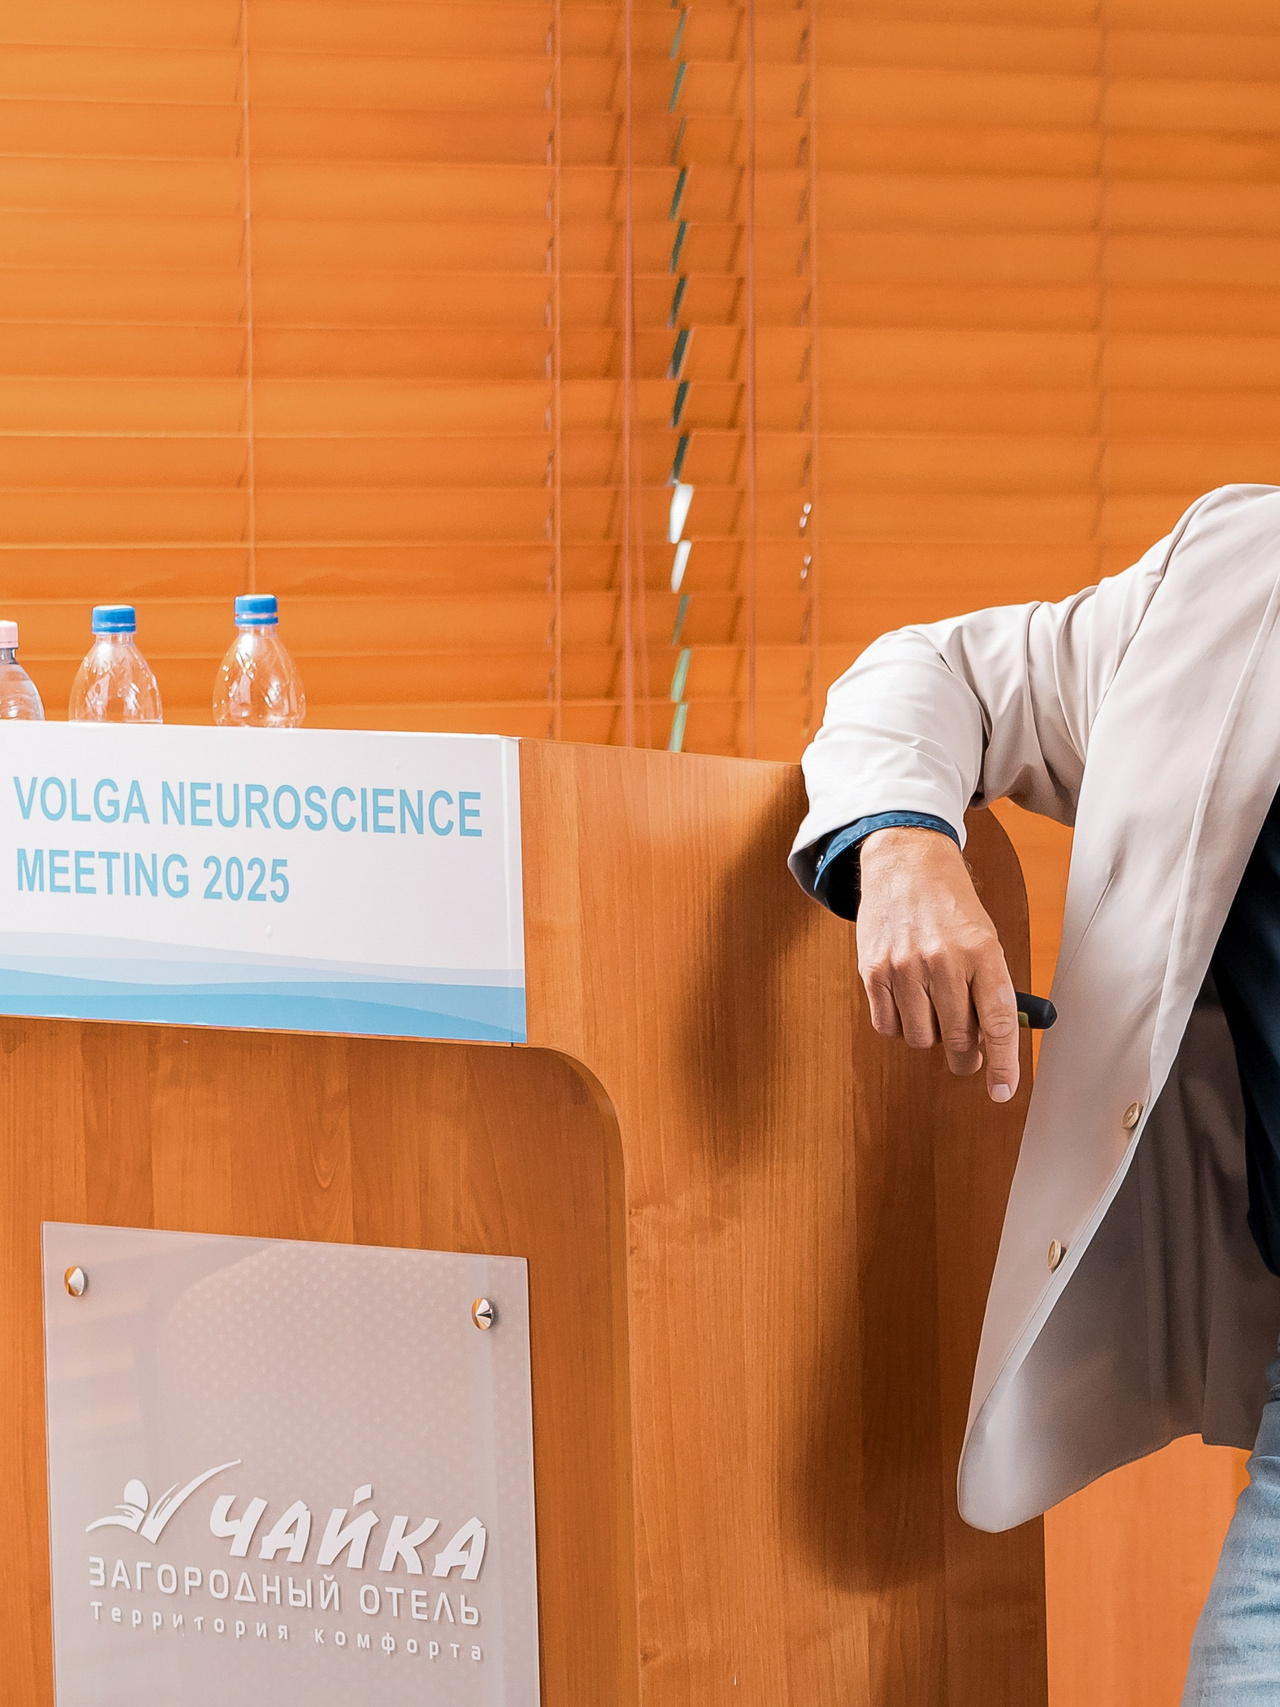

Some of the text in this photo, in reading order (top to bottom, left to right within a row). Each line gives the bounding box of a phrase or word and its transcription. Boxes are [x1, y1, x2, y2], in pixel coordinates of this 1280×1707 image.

[13, 776, 483, 838] VOLGA NEUROSCIENCE
[16, 848, 290, 904] MEETING 2025
[209, 1483, 487, 1580] ЧАЙКА
[89, 1556, 480, 1625] ЗАГОРОДНЫЙ ОТЕЛЬ
[90, 1601, 482, 1661] Территория комфорта
